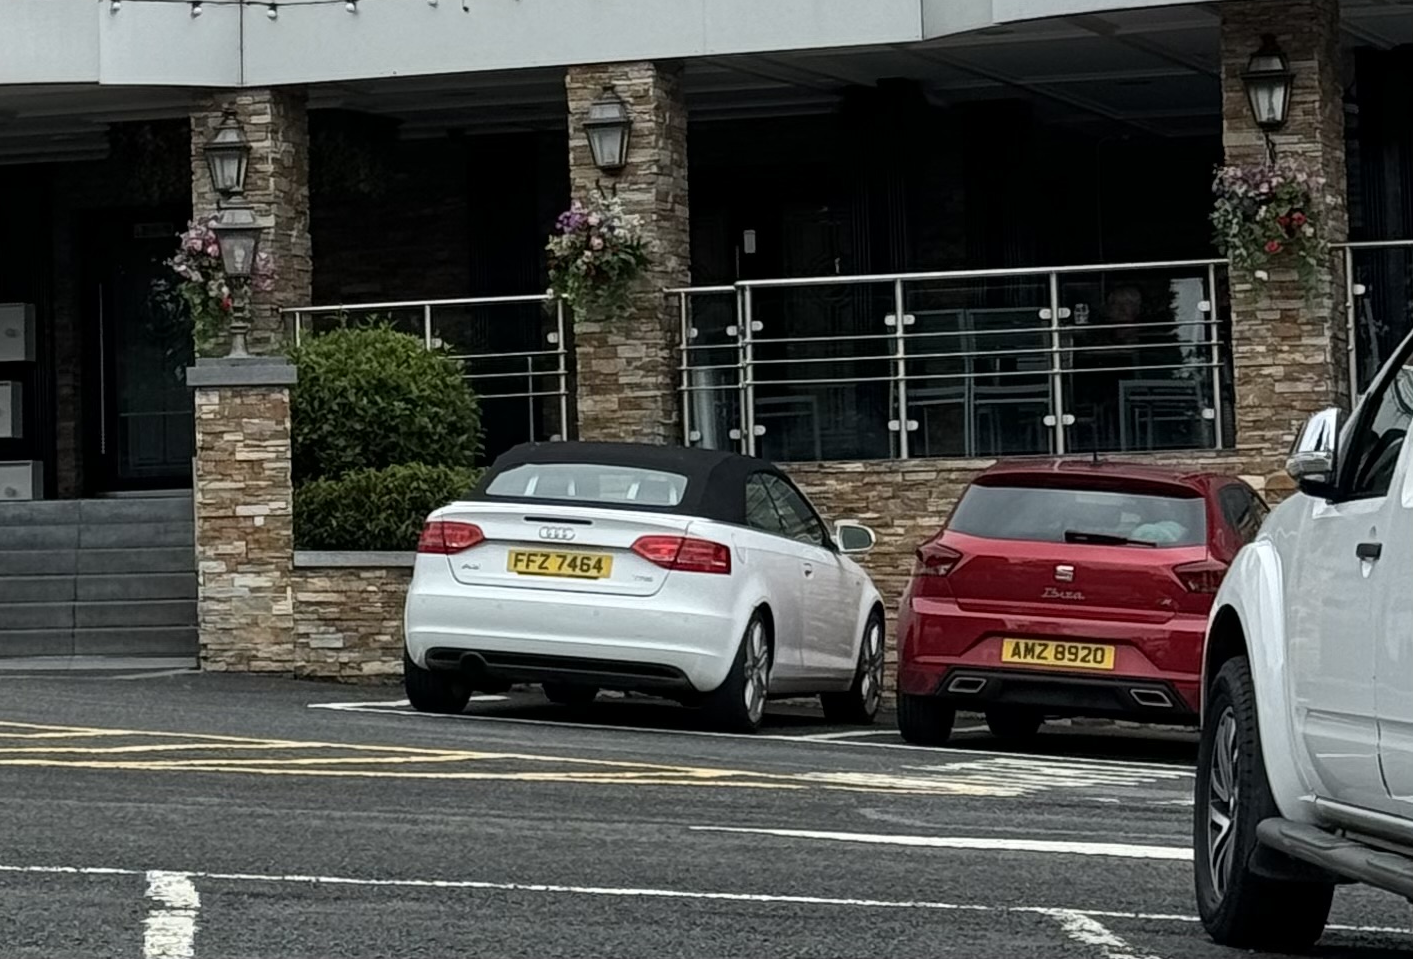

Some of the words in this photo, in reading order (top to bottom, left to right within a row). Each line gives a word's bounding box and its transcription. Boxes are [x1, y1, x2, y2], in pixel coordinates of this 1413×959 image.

[513, 553, 550, 570] FFZ
[556, 554, 603, 573] 7464
[1011, 641, 1048, 660] AMZ
[1054, 644, 1105, 664] 8920
